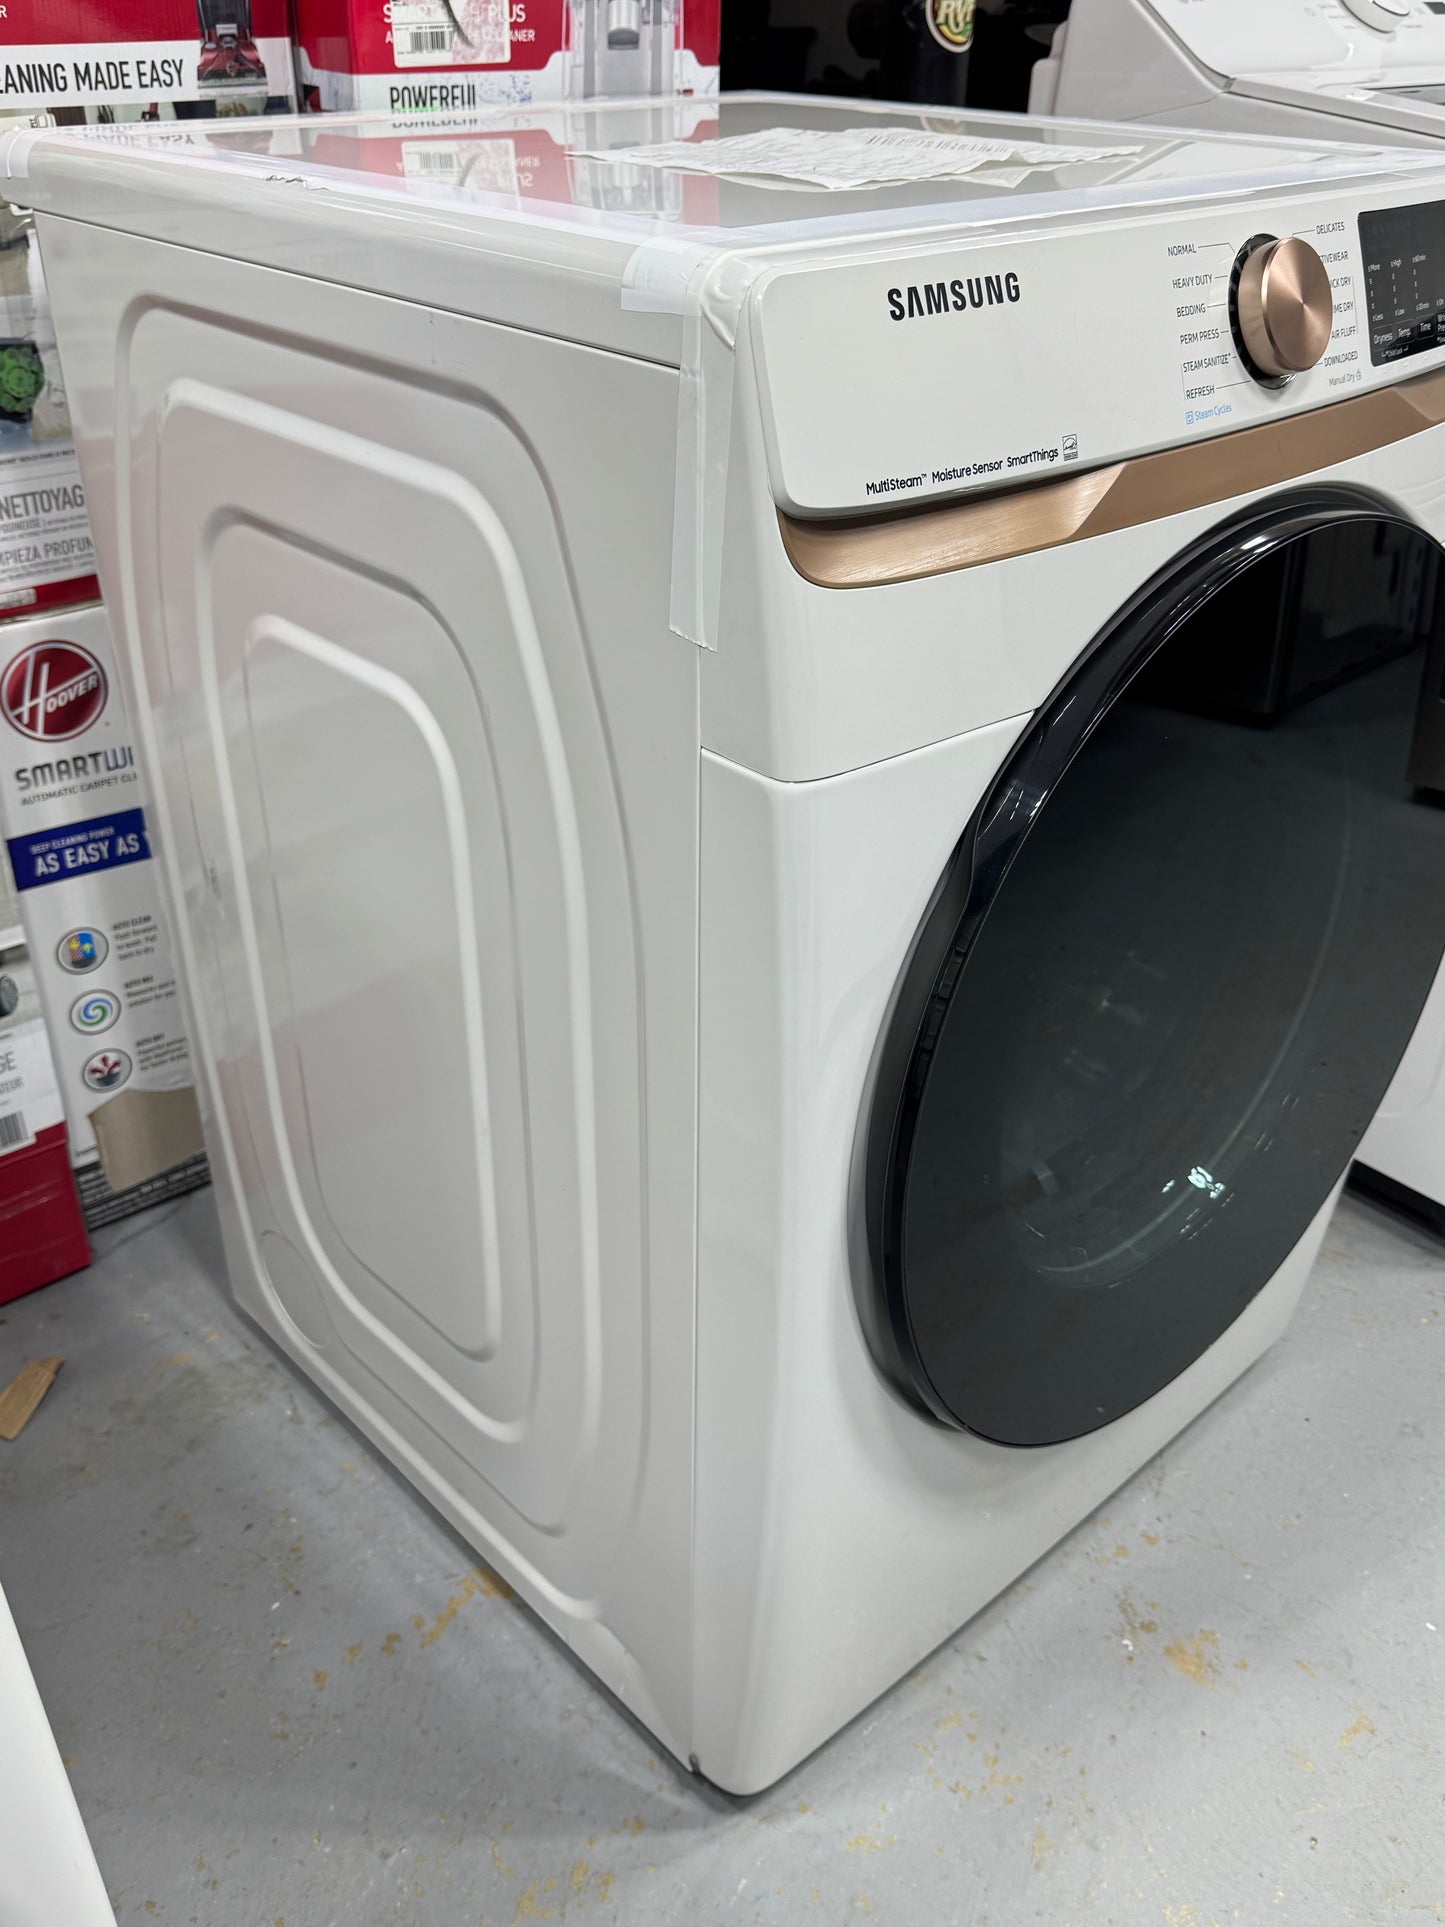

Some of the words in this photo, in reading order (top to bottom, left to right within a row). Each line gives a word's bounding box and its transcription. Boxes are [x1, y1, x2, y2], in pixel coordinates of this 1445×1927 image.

[0, 63, 68, 94] ANING
[73, 61, 132, 92] MADE
[136, 59, 184, 90] EASY
[1316, 221, 1345, 235] DELICATES
[1167, 243, 1197, 256] NORMAL
[1172, 277, 1195, 289] HEAVY
[1195, 274, 1213, 286] DUTY
[1340, 276, 1351, 287] DRY
[887, 272, 1021, 321] SAMSUNG
[1176, 303, 1206, 317] BEDDING
[1343, 301, 1354, 312] DRY
[1340, 326, 1356, 337] FLUFF
[1420, 322, 1431, 332] Time
[1180, 331, 1199, 344] PERM
[1199, 328, 1219, 341] PRESS
[1373, 332, 1393, 345] Dryness
[1183, 359, 1204, 372] STEAM
[1324, 350, 1359, 367] DOWNLOADED
[1329, 374, 1346, 386] Manual
[1346, 372, 1355, 382] Dry
[1186, 385, 1215, 399] REFRESH
[1195, 408, 1213, 420] Steam
[1214, 403, 1232, 416] Cycles
[932, 467, 972, 484] Moisture
[972, 459, 1003, 475] Sensor
[1007, 448, 1059, 467] SmartThings
[22, 785, 78, 806] AUTOMATIC
[80, 777, 118, 793] CARPET
[51, 832, 89, 849] CLEANING
[89, 826, 115, 841] POWER
[36, 853, 60, 876] AS
[64, 840, 109, 869] EASY
[116, 833, 140, 856] AS
